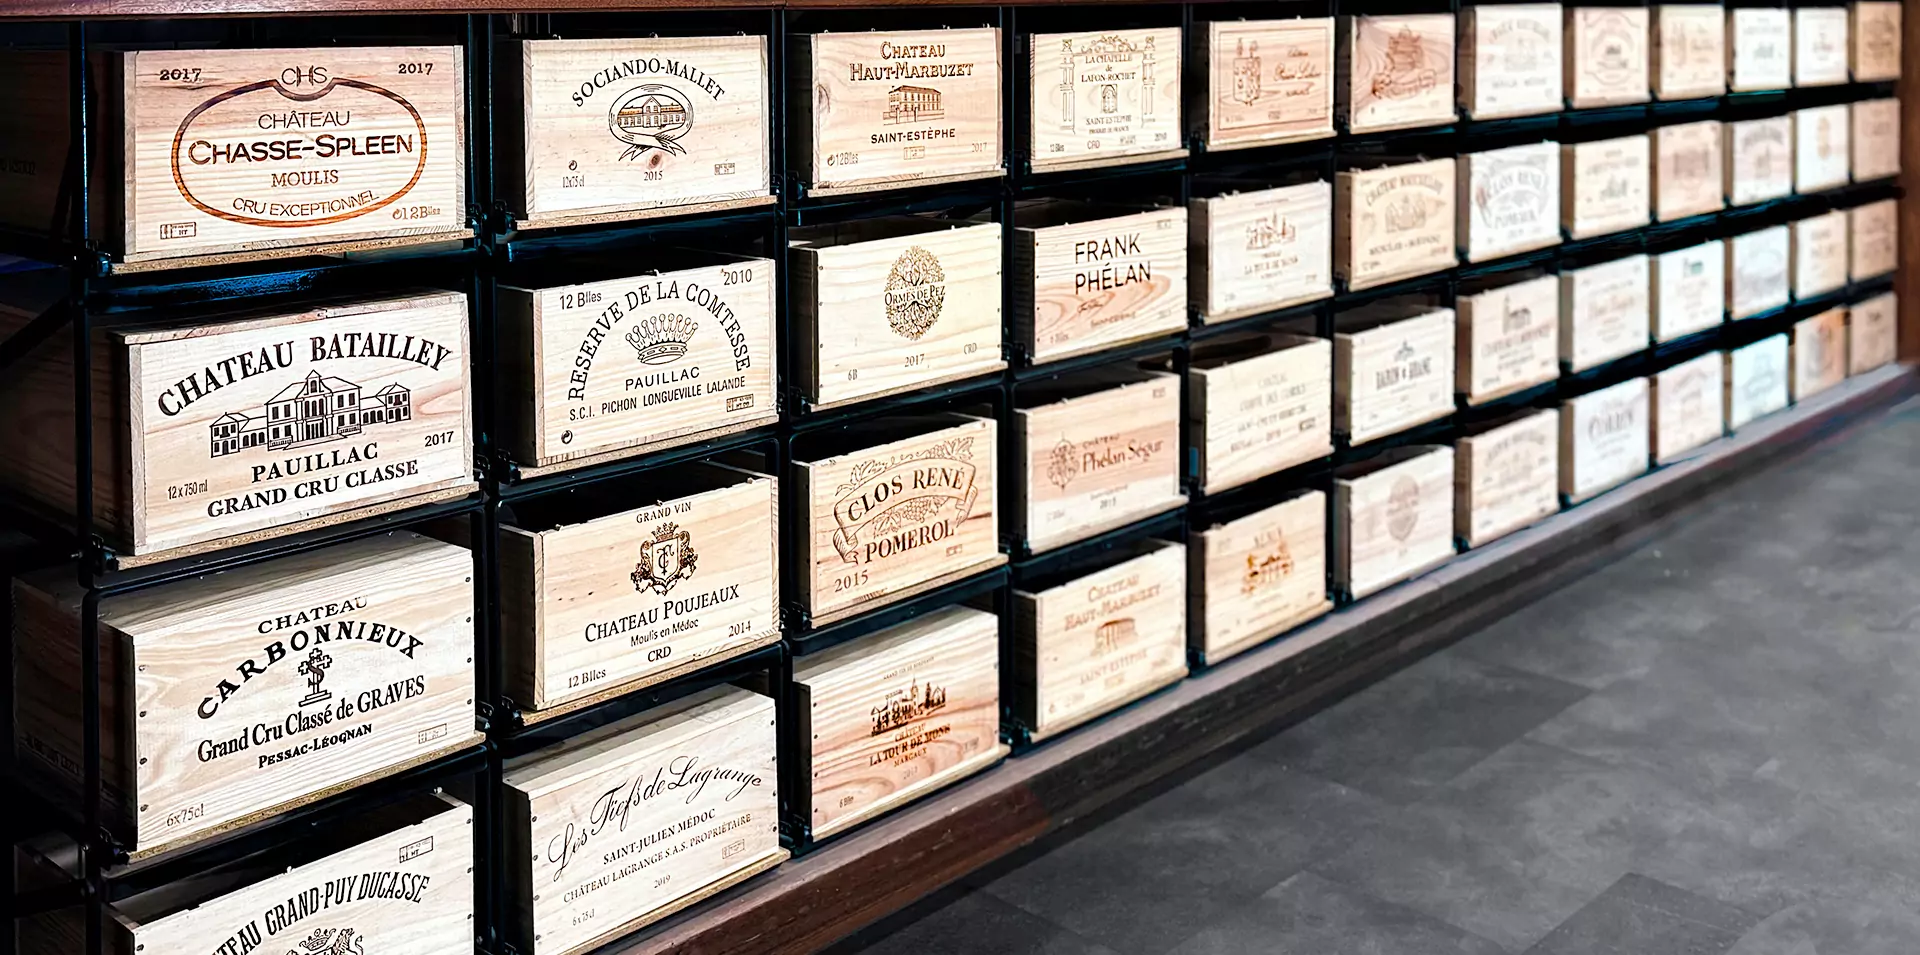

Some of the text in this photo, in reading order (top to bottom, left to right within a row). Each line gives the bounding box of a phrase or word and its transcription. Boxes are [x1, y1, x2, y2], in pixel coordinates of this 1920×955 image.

[881, 41, 945, 60] CHATEAU
[160, 68, 202, 81] 2017
[281, 65, 327, 86] CHS
[398, 62, 433, 75] 2017
[572, 58, 725, 107] SOCIANDO-MALLET
[850, 62, 974, 81] HAUT-MARBUZET
[258, 110, 350, 129] CHÂTEAU
[188, 134, 413, 165] CHASSE-SPLEEN
[871, 127, 956, 144] SAINT-ESTÈPHE
[271, 169, 339, 187] MOULIS
[644, 171, 663, 181] 2015
[233, 190, 379, 216] CRU EXCEPTIONNEL
[1075, 232, 1140, 264] FRANK
[724, 269, 752, 286] 2010
[1075, 260, 1151, 295] PHÉLAN
[560, 294, 573, 310] 12
[884, 284, 946, 306] ORMES DE PEZ
[568, 280, 751, 401] RESERVE DE LA COMTESSE
[158, 332, 454, 417] CHATEAU BATAILLEY
[904, 354, 924, 368] 2017
[625, 366, 700, 391] PAUILLAC
[570, 376, 746, 420] S.C.I. PICHON LONGUEVILLE LALANDE
[424, 431, 454, 447] 2017
[251, 442, 379, 483] PAUILLAC
[208, 460, 418, 518] GRAND CRU CLASSE
[848, 467, 965, 522] CLOS RENÉ
[636, 502, 692, 524] GRAND VIN
[864, 520, 954, 564] POMEROL
[834, 570, 868, 593] 2015
[258, 596, 368, 634] CHATEAU
[584, 584, 740, 642] CHATEAU POUJEAUX
[630, 618, 699, 648] Moulis en Médoc
[728, 621, 752, 638] 2014
[648, 646, 672, 662] CRD
[198, 620, 424, 720] CARBONNIEUX
[568, 676, 579, 688] 12
[198, 675, 424, 762] Grand Cru Classé de GRAVES
[258, 723, 372, 768] PESSAC-LÉOGNAN
[869, 751, 882, 767] LA
[882, 740, 908, 761] TOUR
[910, 735, 924, 750] DE
[894, 748, 927, 768] MARGAUX
[548, 756, 762, 882] Les Fiefs de Lagrange
[603, 808, 716, 865] SAINT-JULIEN MÉDOC
[564, 874, 610, 903] CHÂTEAU
[611, 850, 664, 882] LAGRANGE
[664, 842, 688, 858] S.A.S.
[690, 814, 752, 848] PROPRIÉTAIRE
[264, 875, 358, 935] GRAND-PUY
[358, 871, 430, 904] DUCASSE
